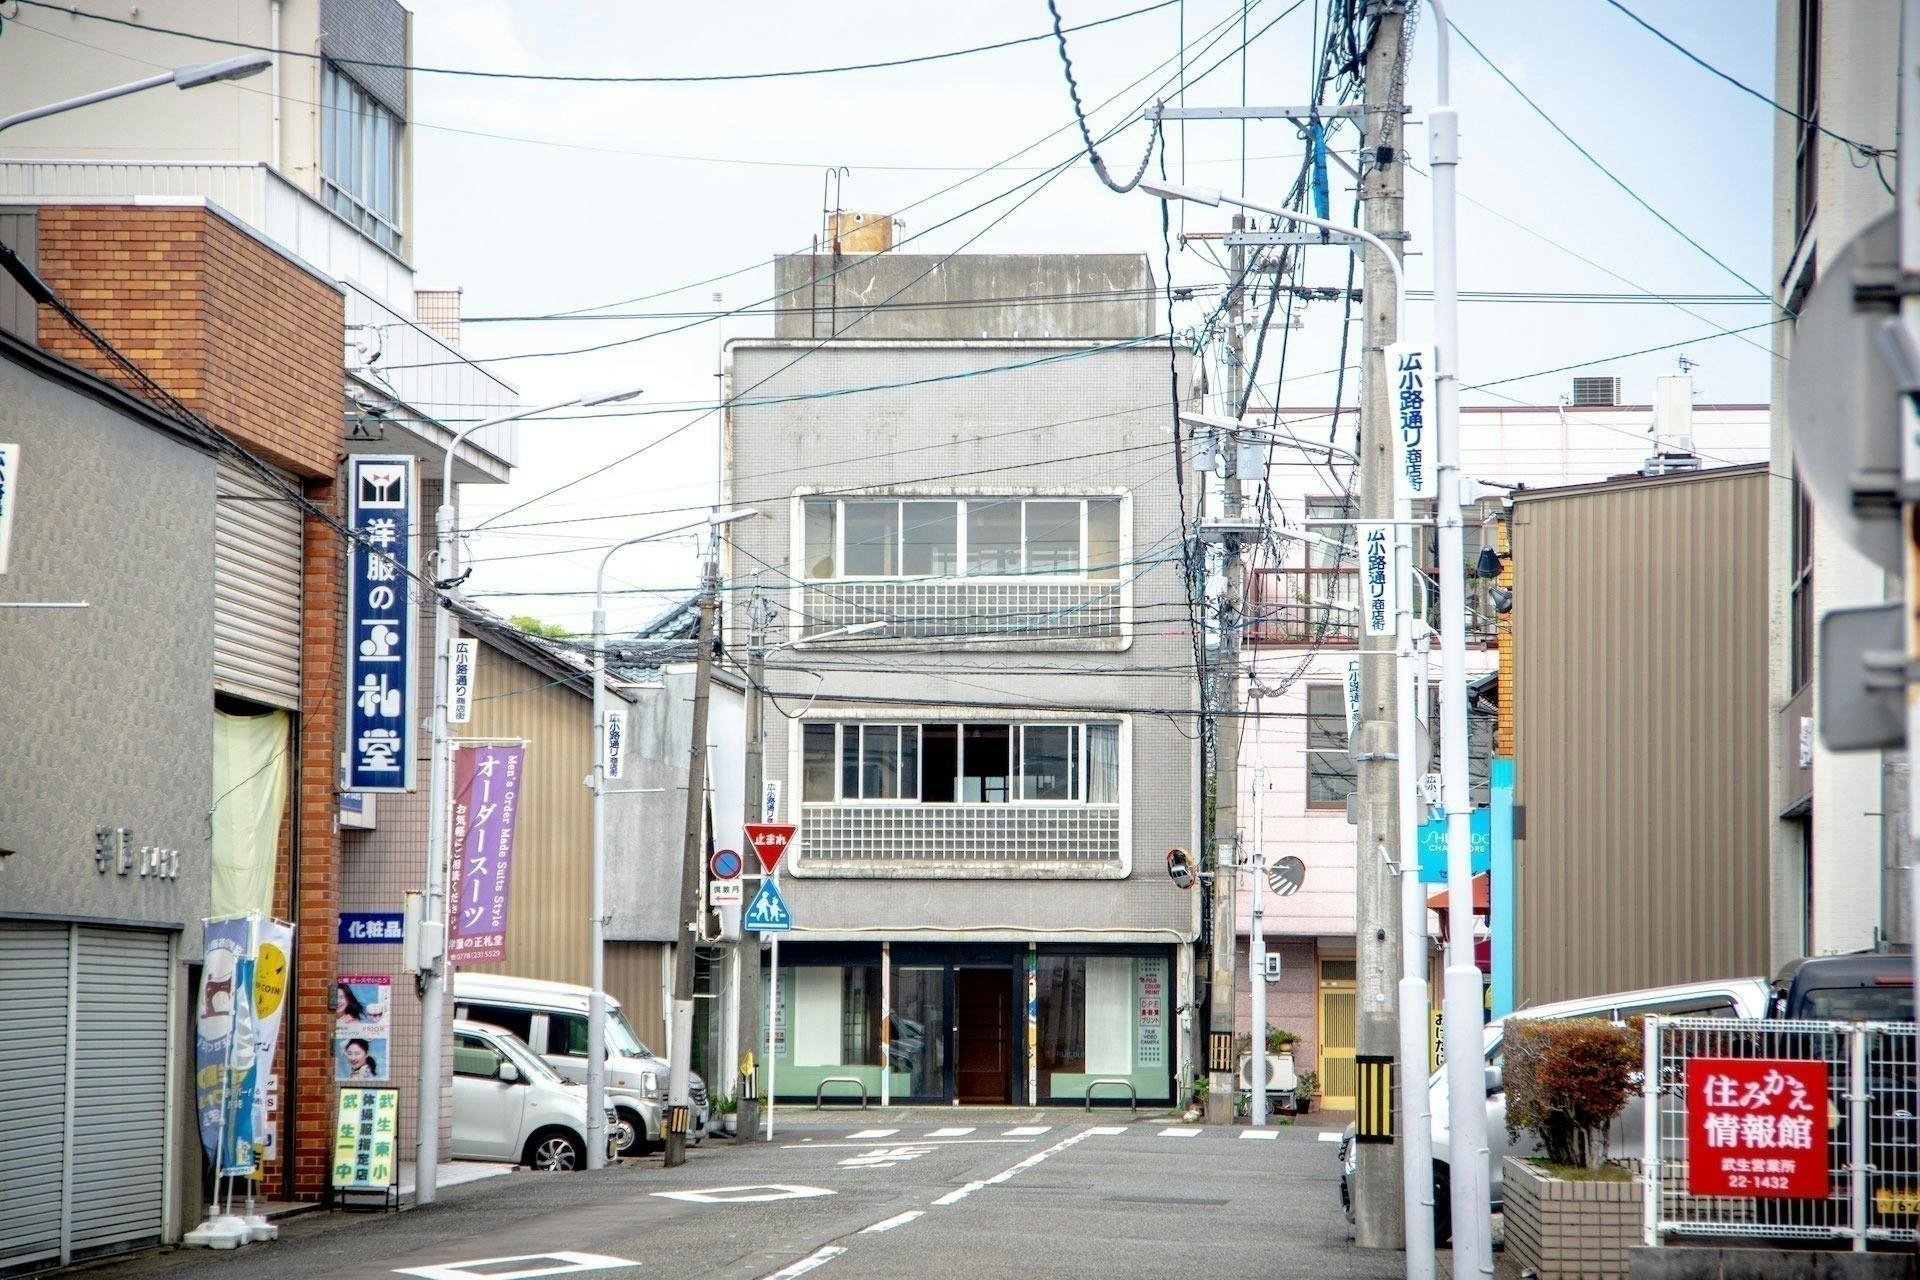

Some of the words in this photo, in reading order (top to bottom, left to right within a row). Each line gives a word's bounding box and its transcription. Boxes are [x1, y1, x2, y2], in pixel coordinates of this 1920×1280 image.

[1398, 351, 1425, 492] 広小路通り商店街
[1367, 527, 1387, 632] 広小路通り商店街
[455, 642, 468, 720] 広小路通り商店街
[608, 713, 621, 777] 広小路通り商店街
[502, 791, 514, 824] Order
[464, 755, 500, 929] オーダースーツ
[498, 828, 511, 858] Made
[754, 832, 787, 846] 止まれ
[494, 861, 507, 892] Suits
[713, 885, 739, 893] 偶数月
[491, 895, 504, 928] Style
[348, 920, 402, 938] 化粧品
[1703, 1068, 1814, 1110] 住みかえ
[373, 1093, 394, 1180] 武生東小
[1703, 1112, 1813, 1150] 情報館
[1721, 1157, 1796, 1174] 武生営業所
[1728, 1175, 1789, 1190] 22-1432
